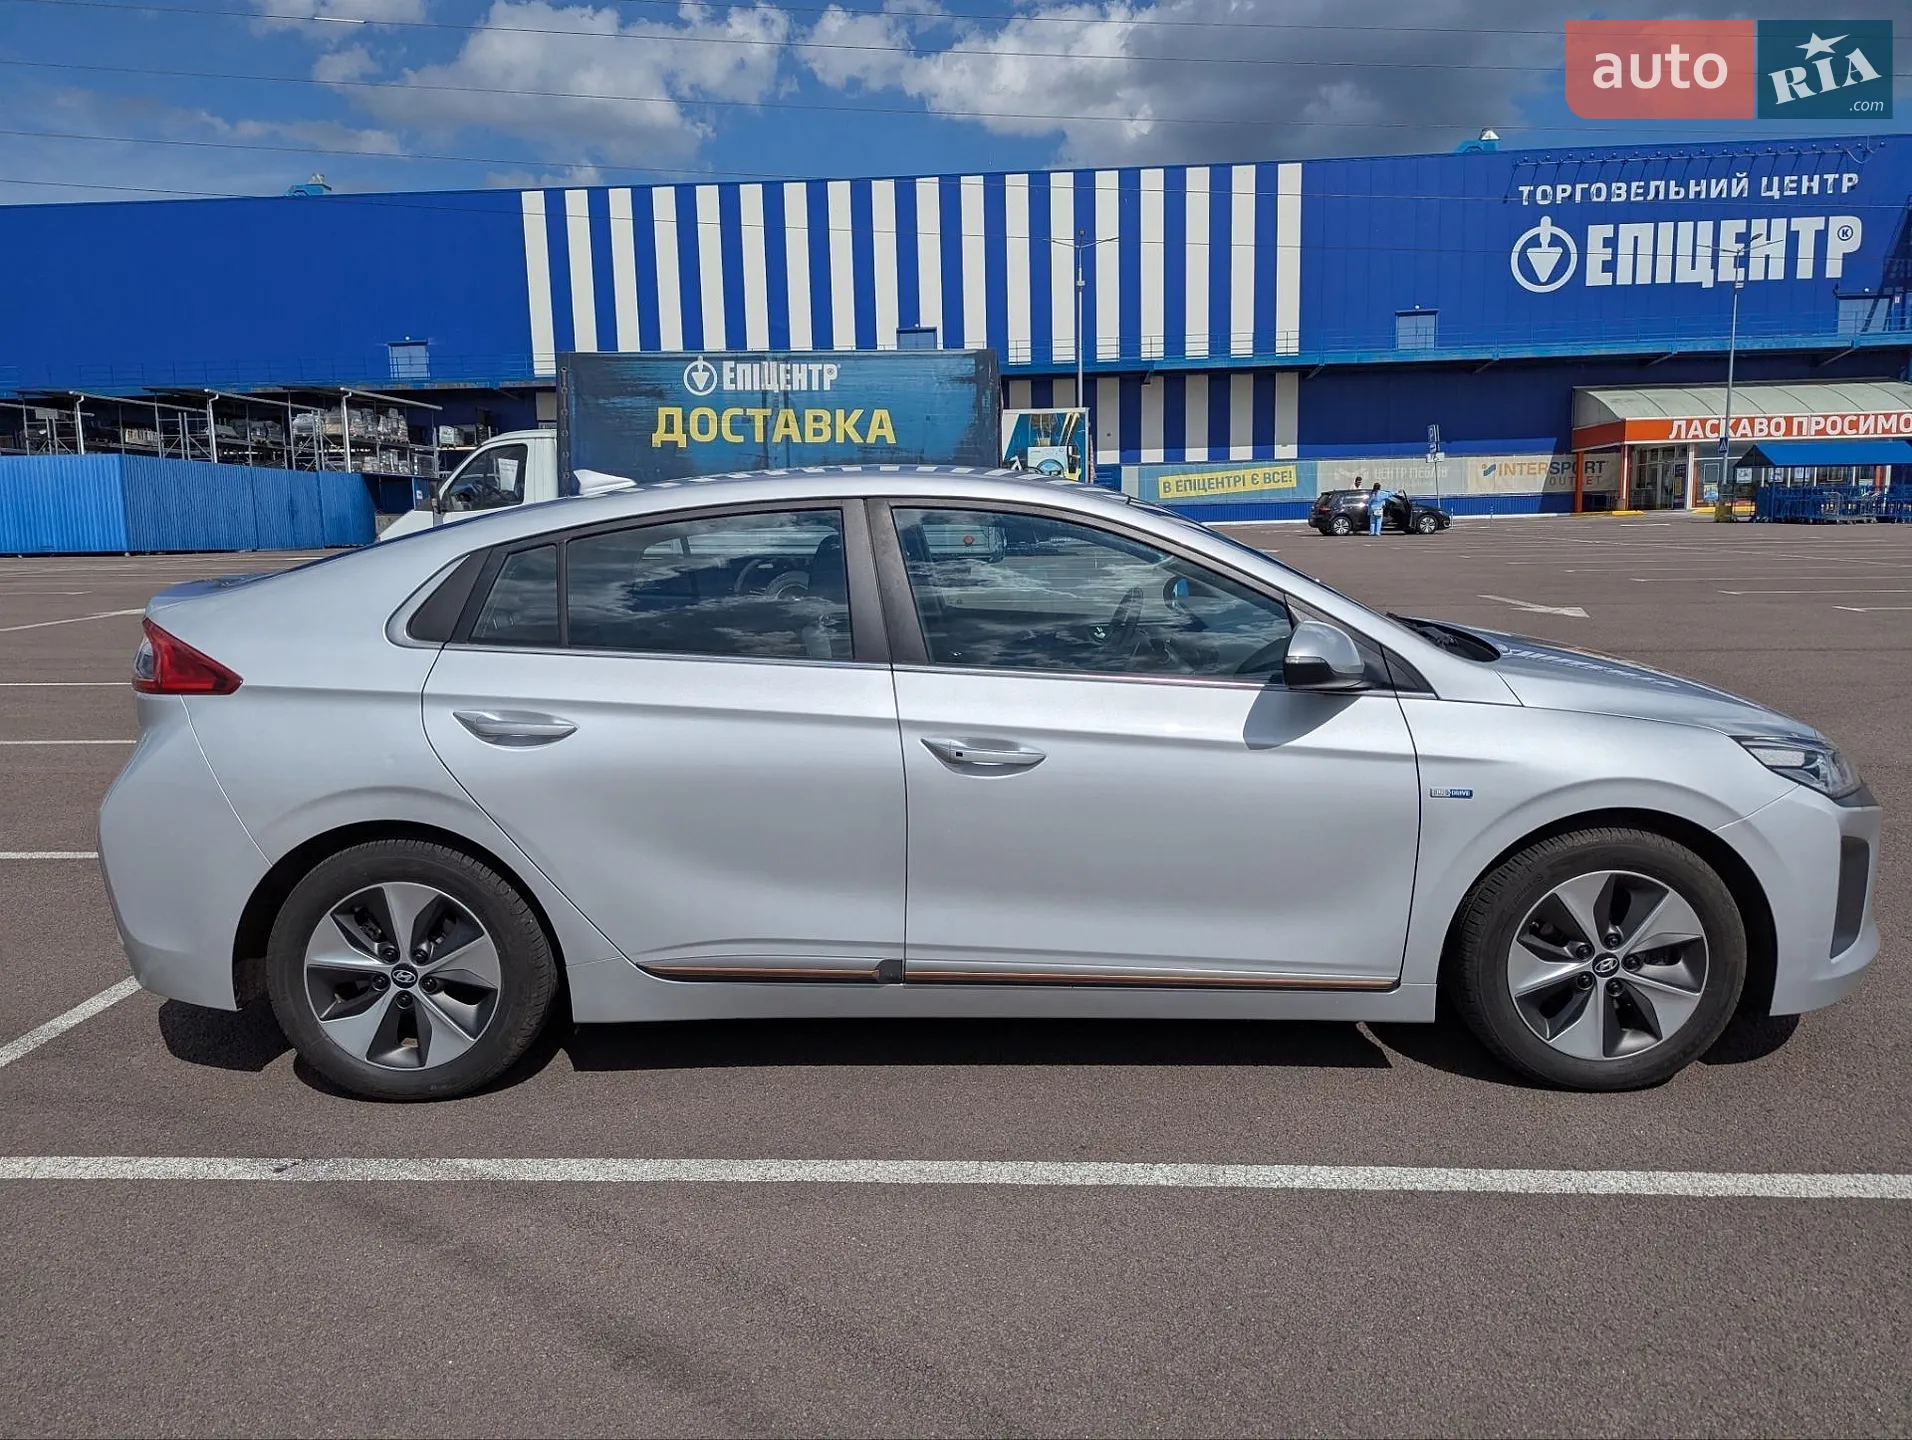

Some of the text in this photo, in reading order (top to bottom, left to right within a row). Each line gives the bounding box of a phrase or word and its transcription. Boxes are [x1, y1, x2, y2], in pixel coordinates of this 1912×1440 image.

[1518, 172, 1859, 206] ТОРГОВЕЛЬНИЙ ЦЕНТР
[1585, 215, 1862, 289] ЕПІЦЕНТР
[723, 361, 838, 393] ЕПІЦЕНТР
[651, 407, 897, 447] ДОСТАВКА
[1668, 417, 1786, 439] ЛАСКАВО
[1163, 470, 1292, 493] В ЕПІЦЕНТРІ Є ВСЕ!
